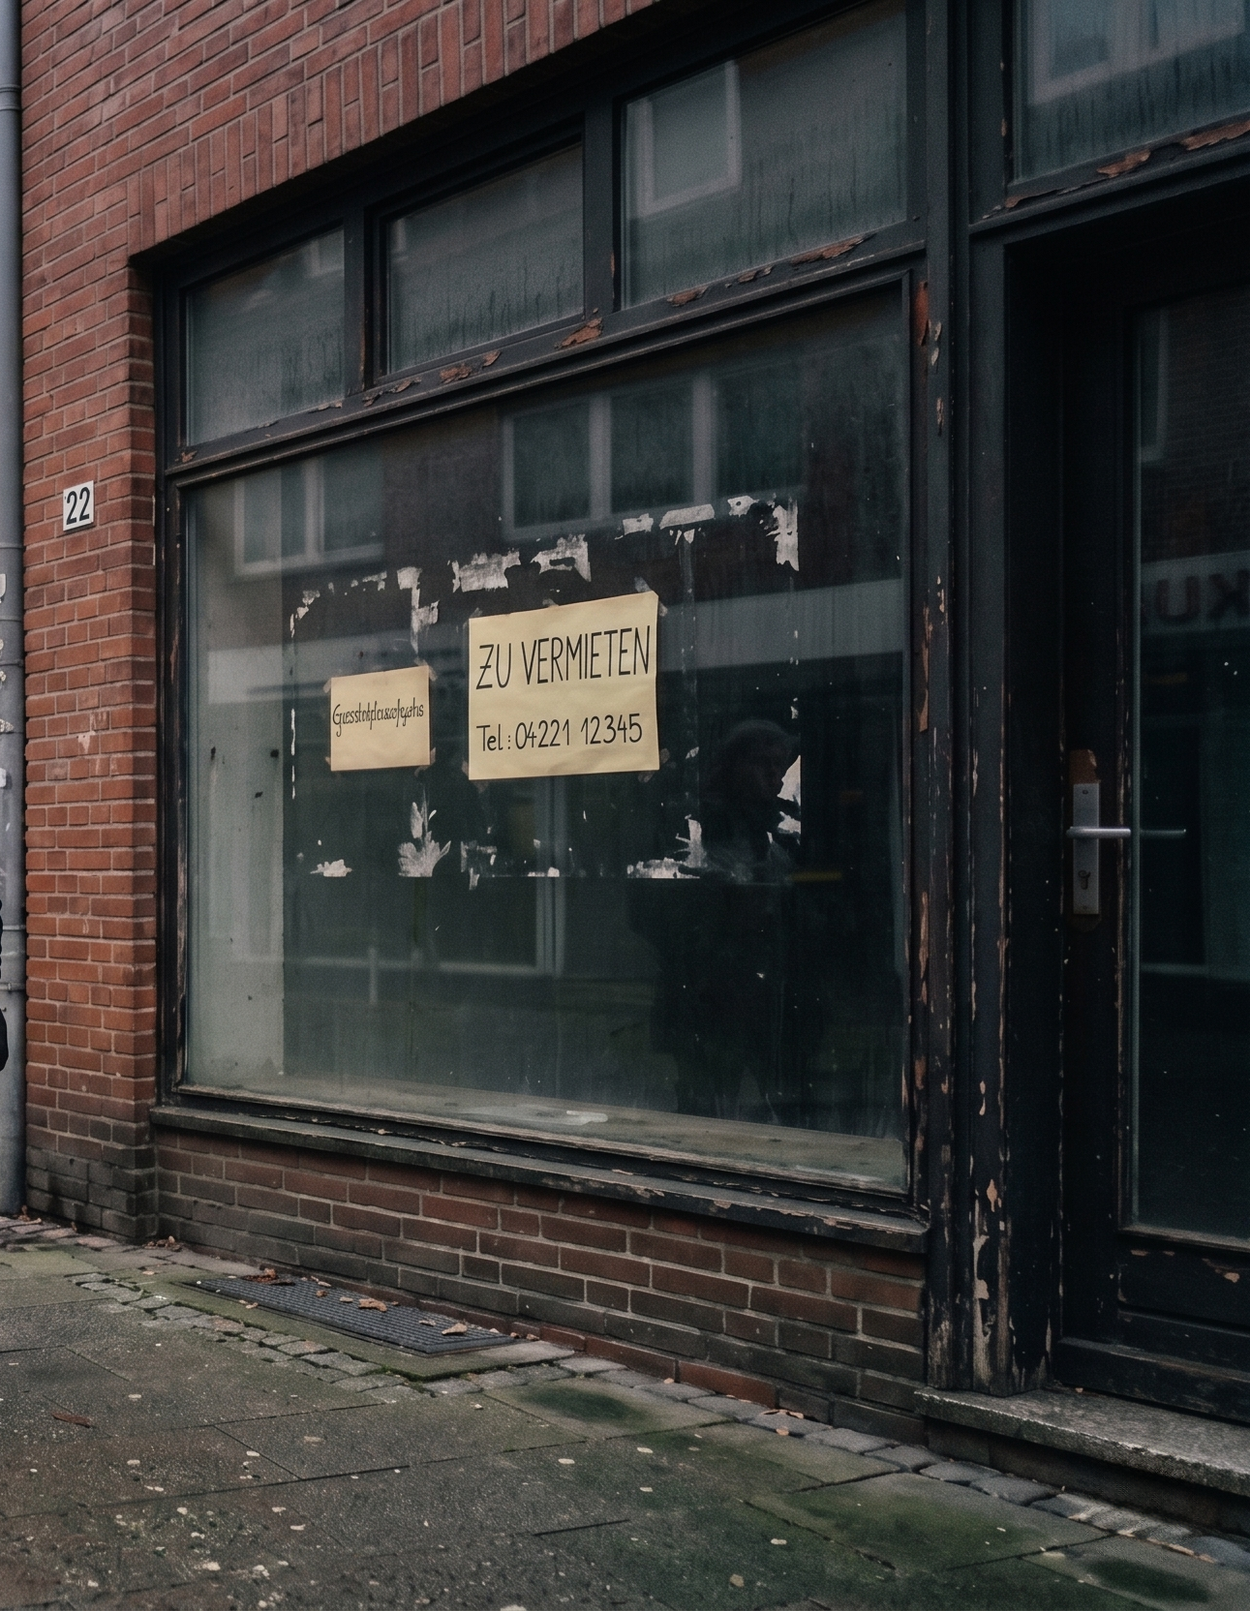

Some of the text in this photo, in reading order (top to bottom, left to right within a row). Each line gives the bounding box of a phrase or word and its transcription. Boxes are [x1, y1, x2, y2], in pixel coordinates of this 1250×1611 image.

[66, 486, 91, 525] 22
[475, 625, 651, 690] ZU VERMIETEN
[515, 718, 571, 750] 04221
[581, 712, 644, 745] 12345
